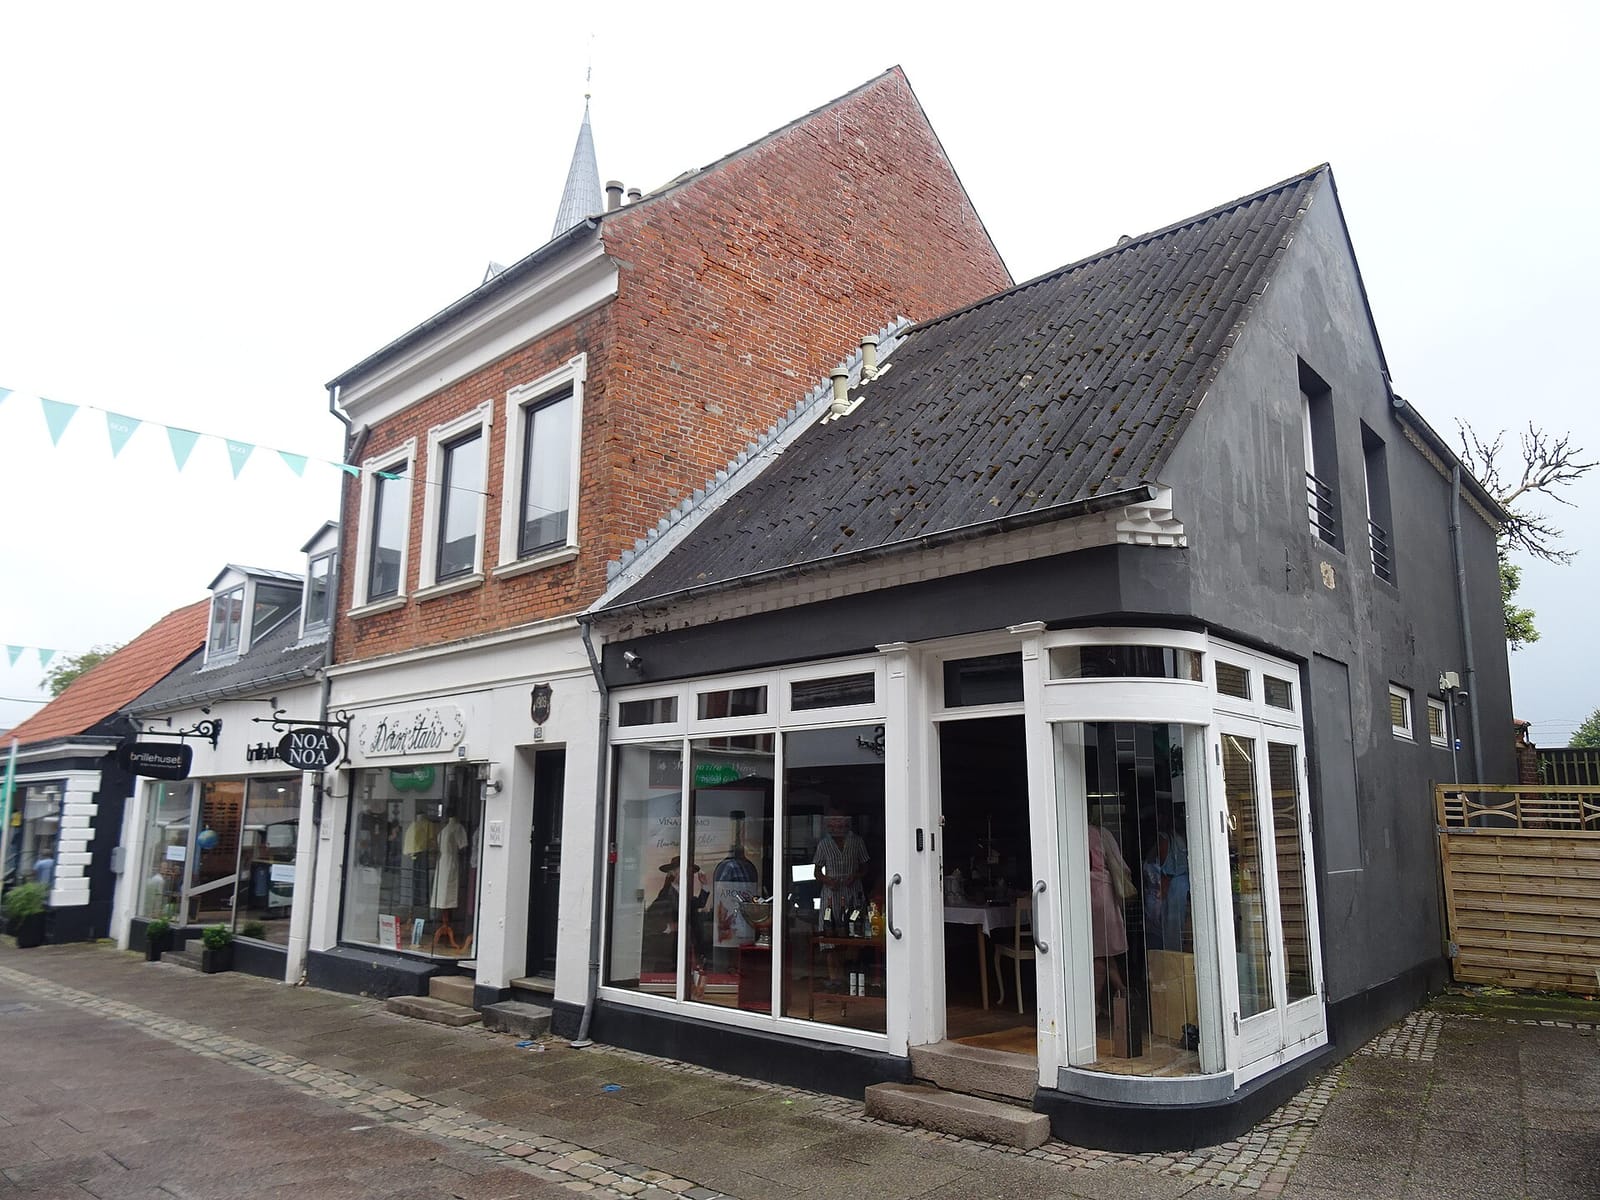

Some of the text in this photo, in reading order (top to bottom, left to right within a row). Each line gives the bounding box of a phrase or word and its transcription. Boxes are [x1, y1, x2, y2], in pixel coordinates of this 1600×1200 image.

[290, 733, 329, 750] NOA
[129, 752, 183, 765] brillehuset
[289, 748, 328, 765] NOA
